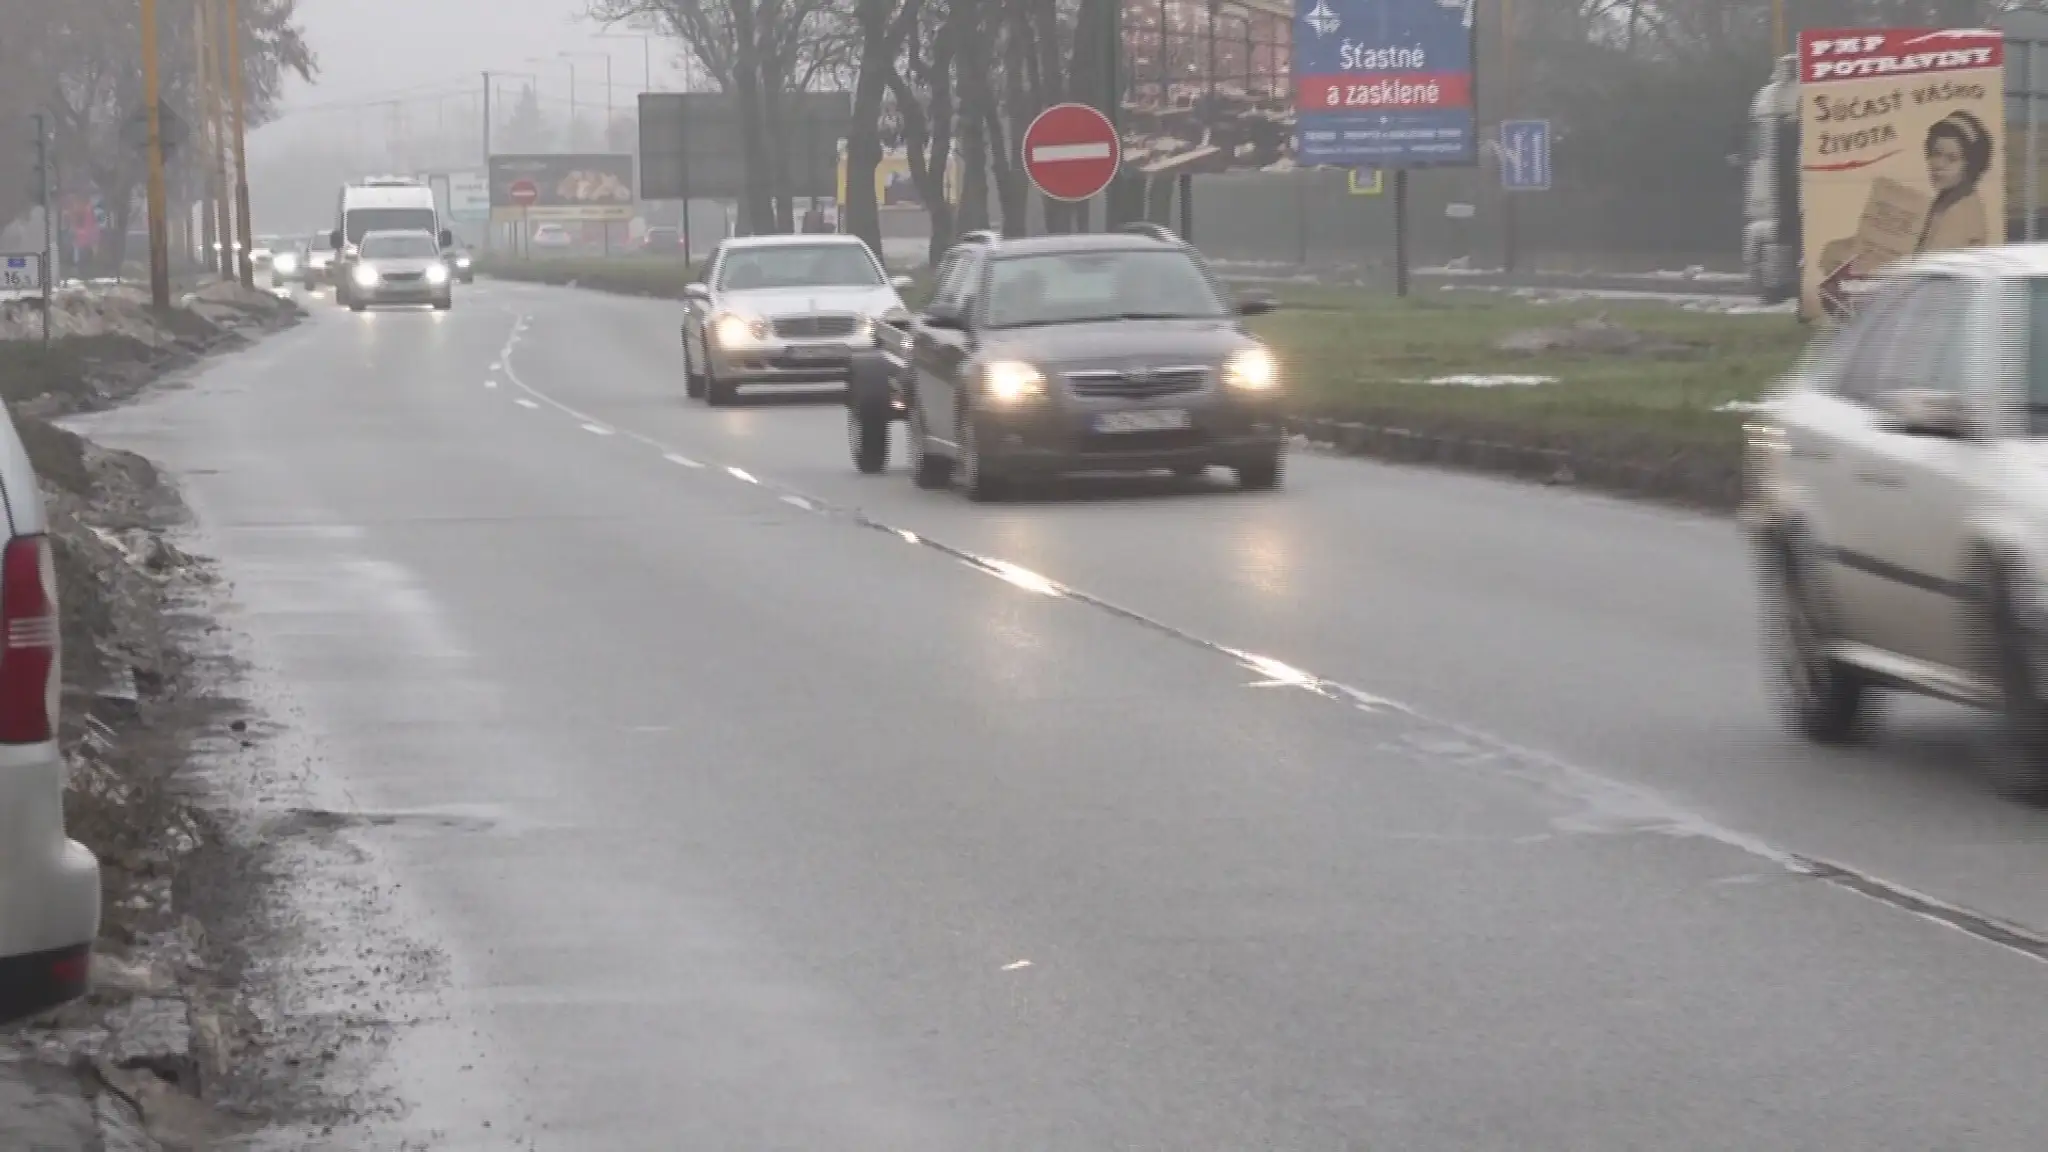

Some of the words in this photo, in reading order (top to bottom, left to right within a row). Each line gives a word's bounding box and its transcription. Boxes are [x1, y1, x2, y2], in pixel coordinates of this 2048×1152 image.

[1340, 38, 1425, 69] Šťastné
[1812, 48, 1992, 79] POTRAVINY
[1326, 86, 1340, 106] a
[1345, 79, 1440, 106] zasklené
